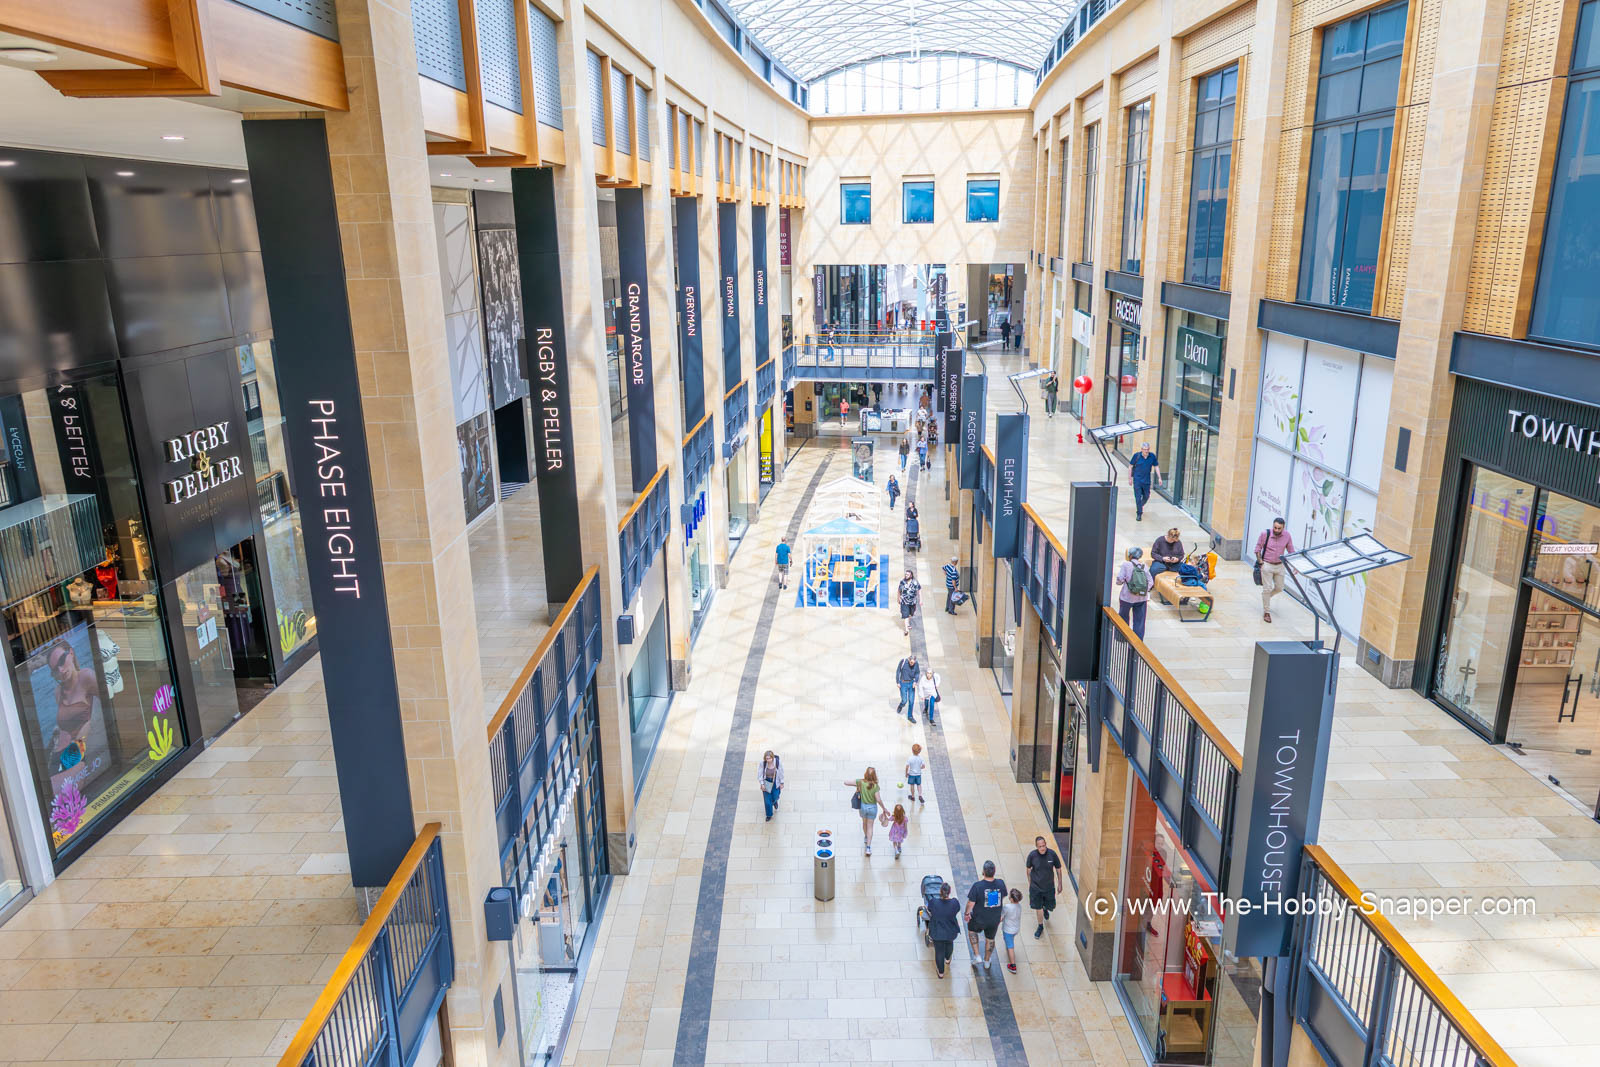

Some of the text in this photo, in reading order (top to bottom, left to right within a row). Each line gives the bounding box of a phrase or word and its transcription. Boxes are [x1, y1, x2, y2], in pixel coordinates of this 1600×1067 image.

[685, 286, 696, 336] EVERYMAN
[726, 276, 735, 317] EVERYMAN
[628, 283, 644, 385] GRAND ARCADE
[1184, 333, 1208, 366] Elem
[536, 328, 563, 471] RIGBY & PELLER
[949, 374, 957, 414] RASPBERRY
[169, 421, 230, 463] RIGBY
[199, 450, 210, 478] &
[170, 456, 244, 505] PELLER
[308, 400, 361, 599] PHASE EIGHT
[1004, 458, 1014, 517] ELEM HAIR
[1543, 545, 1595, 553] TREAT YOURSELF
[91, 779, 130, 811] PRIMADONNA
[1259, 729, 1300, 893] TOWNHOUSE
